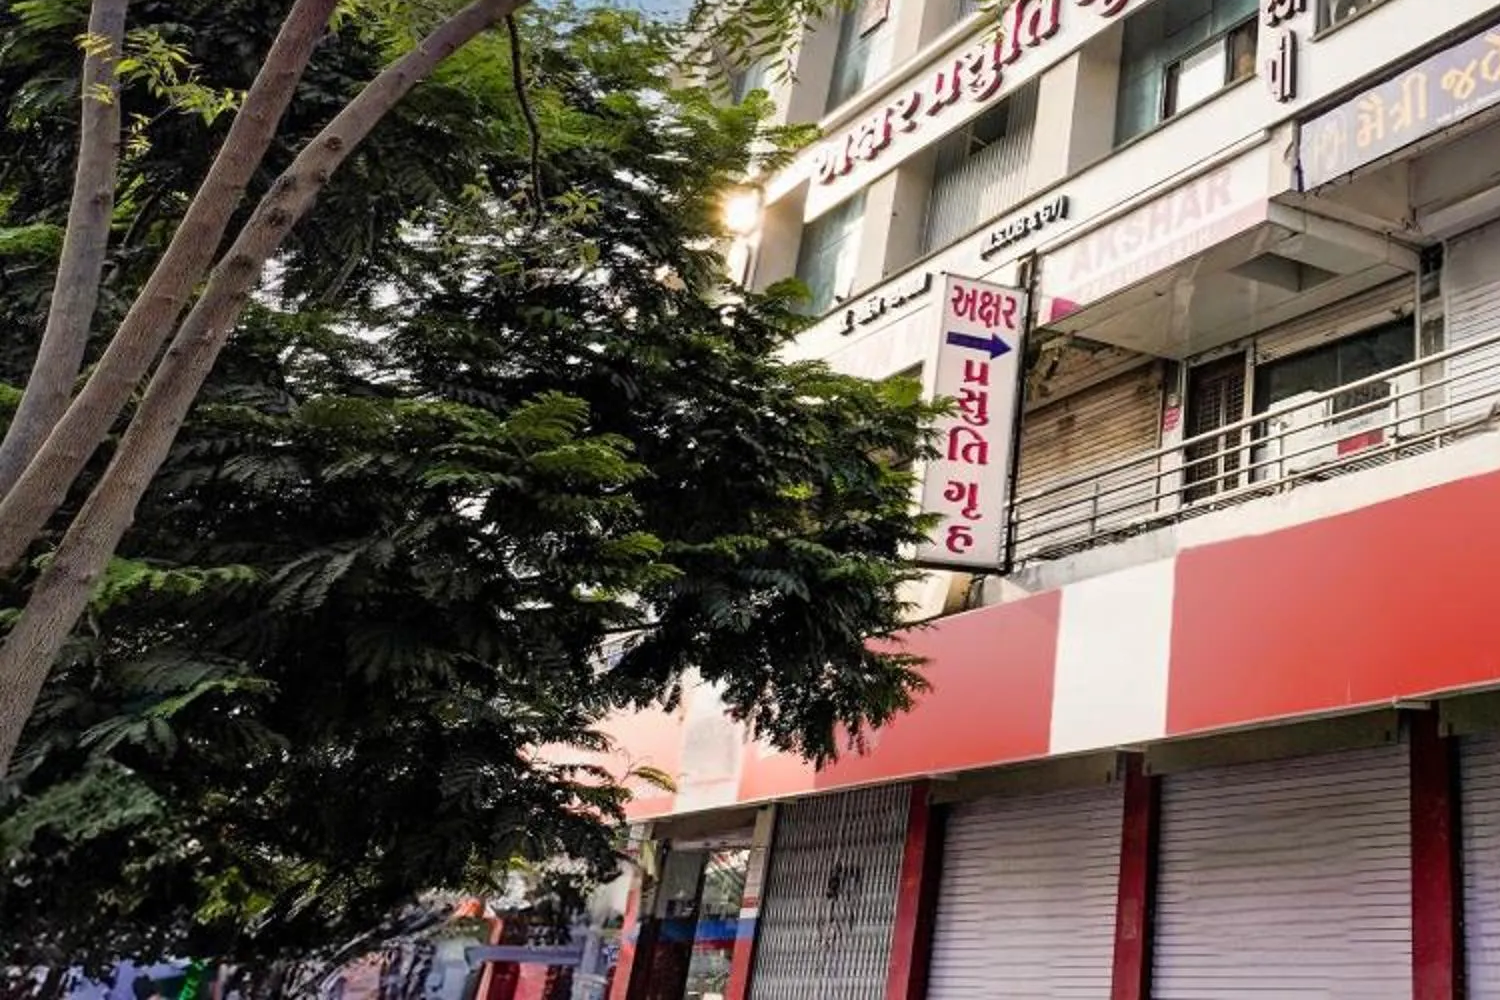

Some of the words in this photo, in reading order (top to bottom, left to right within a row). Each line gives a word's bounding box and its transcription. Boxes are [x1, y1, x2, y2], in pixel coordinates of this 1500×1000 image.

[1355, 70, 1429, 148] મૈત્રી
[1066, 176, 1233, 280] AKSHAR
[951, 284, 1017, 330] અક્ષર
[943, 479, 983, 554] ગૃહ
